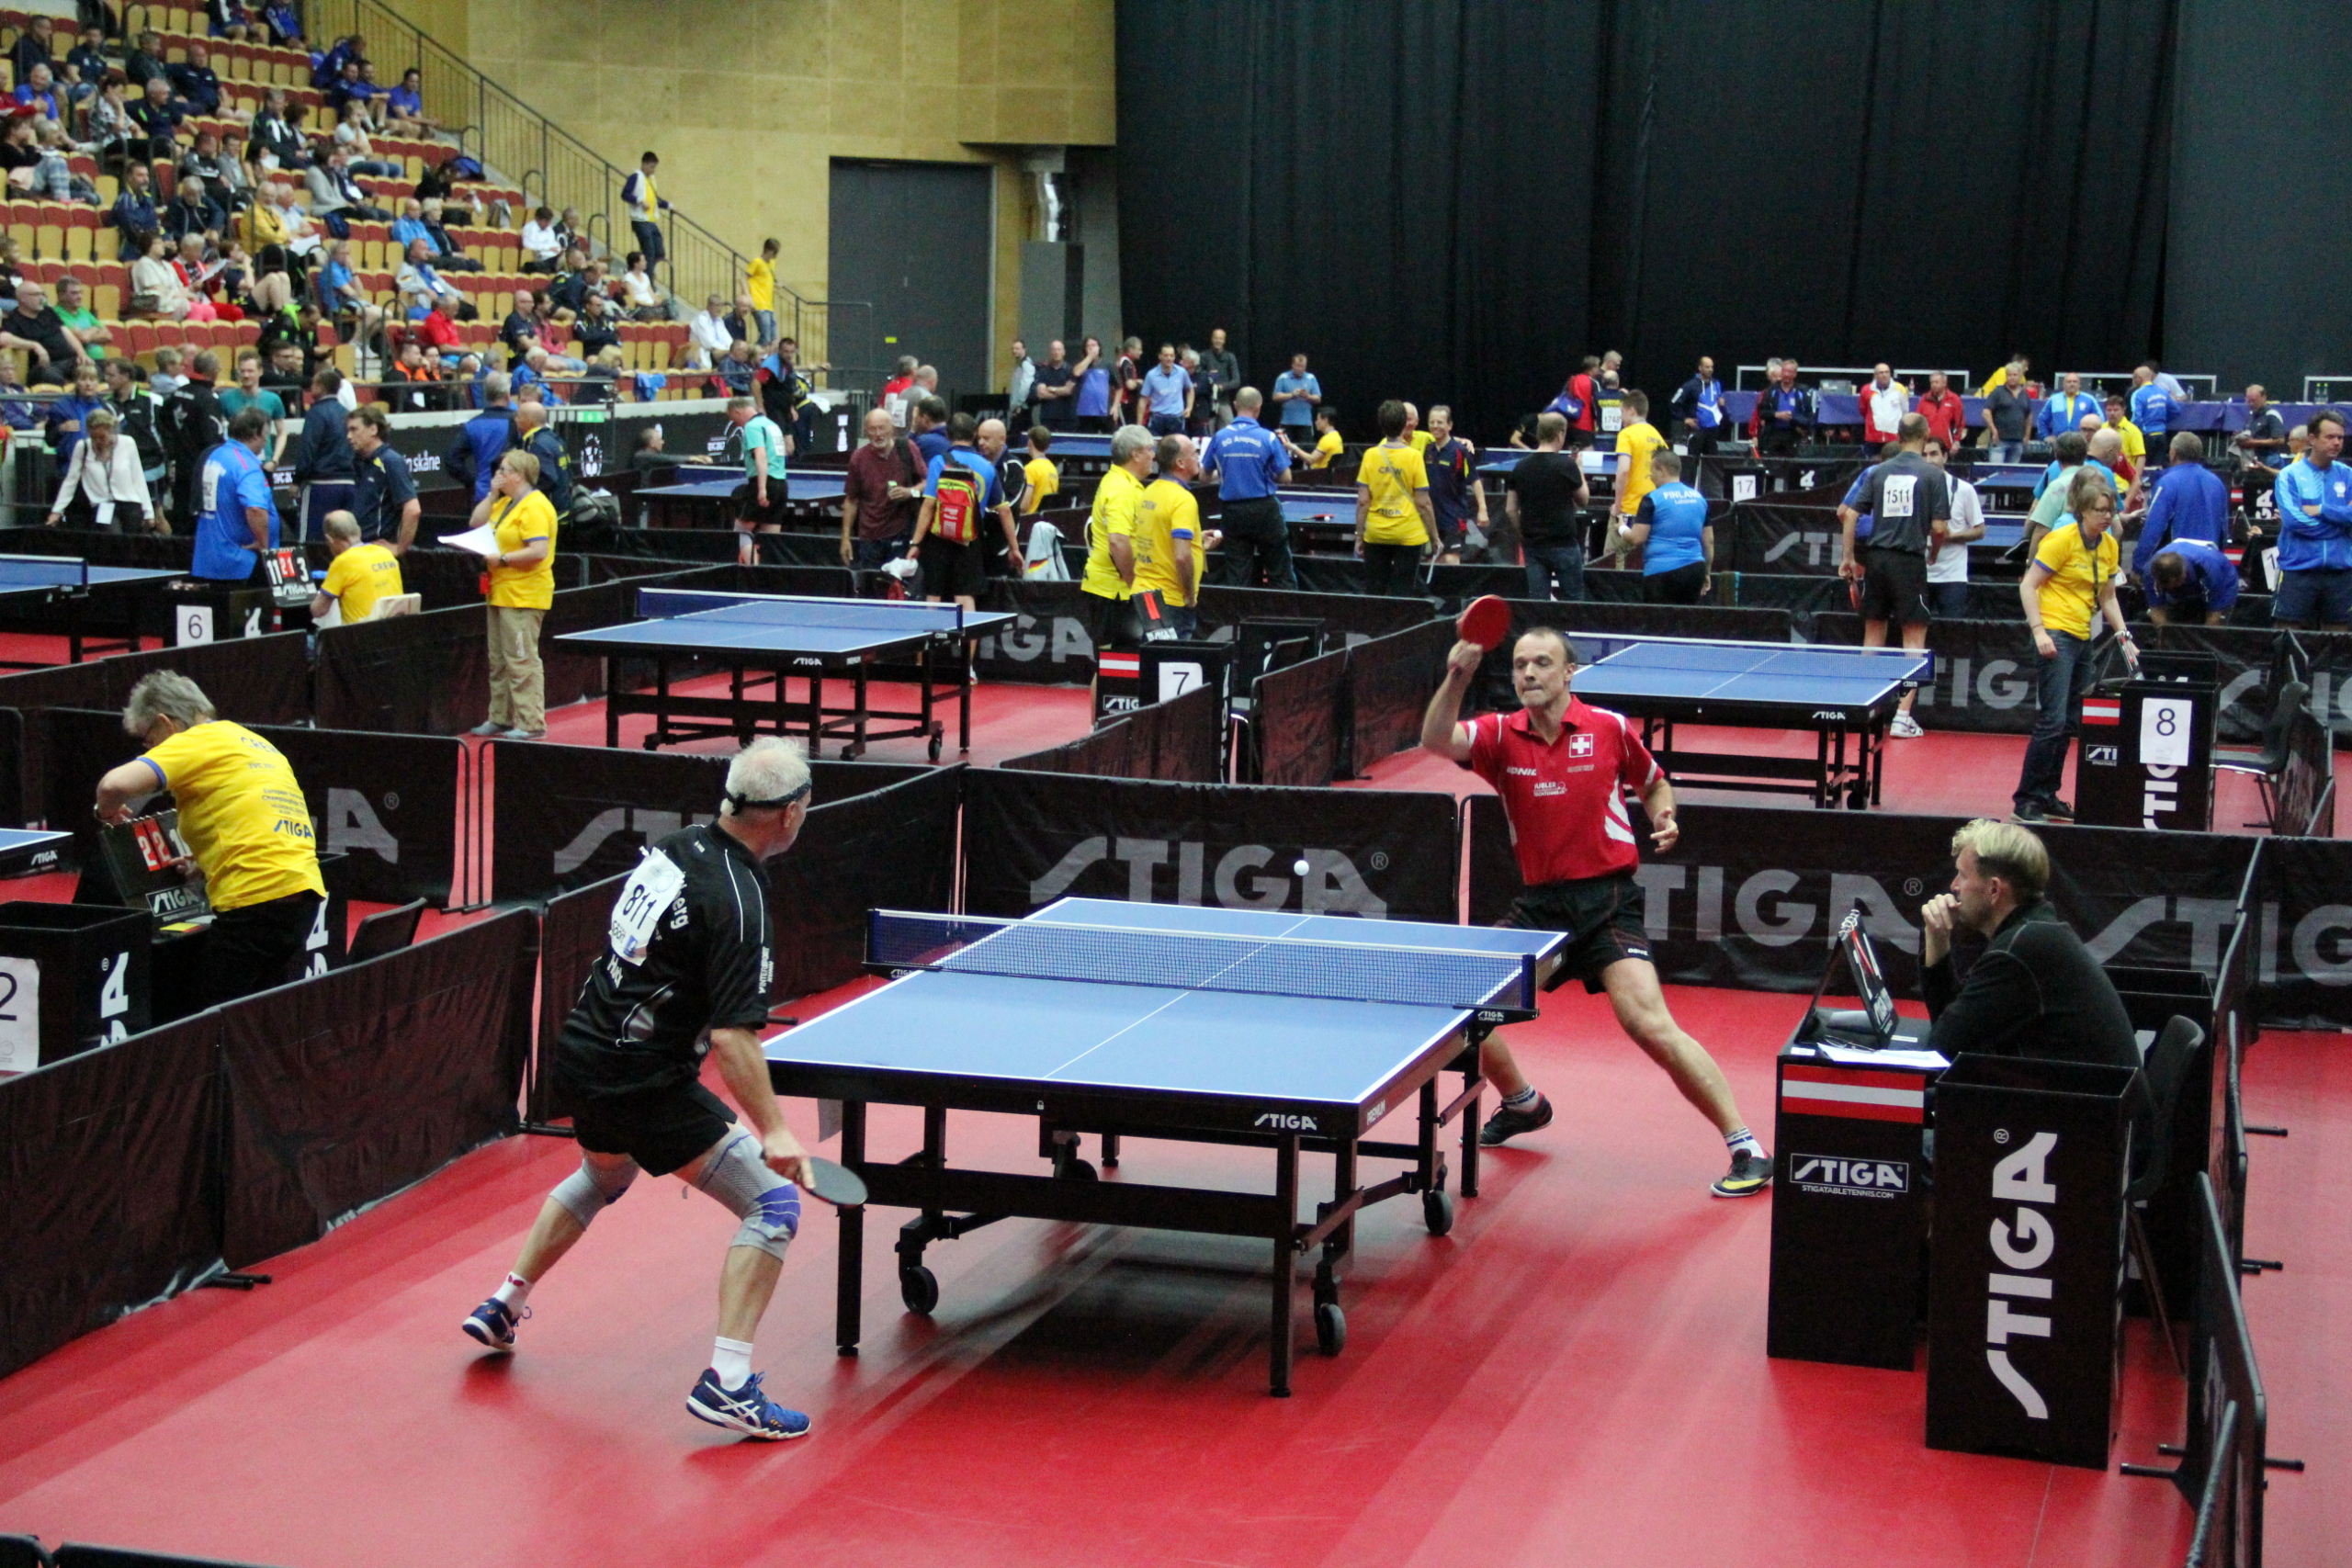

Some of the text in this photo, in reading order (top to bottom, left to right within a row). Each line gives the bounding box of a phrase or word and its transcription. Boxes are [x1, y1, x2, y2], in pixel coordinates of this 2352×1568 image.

[413, 450, 441, 473] skåne
[1736, 479, 1755, 494] 17
[1886, 489, 1910, 504] 1511
[1764, 531, 1844, 566] STI
[297, 557, 309, 582] 3
[371, 560, 397, 572] CREW
[188, 614, 203, 639] 6
[793, 657, 822, 666] STIGA
[1172, 671, 1190, 695] 7
[1104, 697, 1139, 710] STIG
[1812, 711, 1846, 720] STIGA
[2156, 708, 2176, 737] 8
[2087, 747, 2118, 761] STI
[274, 819, 314, 839] STIGA
[31, 850, 58, 865] STIGA
[1030, 835, 1387, 920] STIGA
[153, 888, 199, 914] STIGA
[622, 883, 657, 931] 811
[1632, 863, 1921, 955] TIGA
[2084, 895, 2352, 987] STIG
[1477, 1010, 1504, 1019] STIGA
[1254, 1112, 1317, 1131] STIGA
[1794, 1158, 1904, 1189] STIGA
[1802, 1184, 1894, 1200] STIGATABLETENNIS.COM
[1986, 1131, 2058, 1419] STIGA
